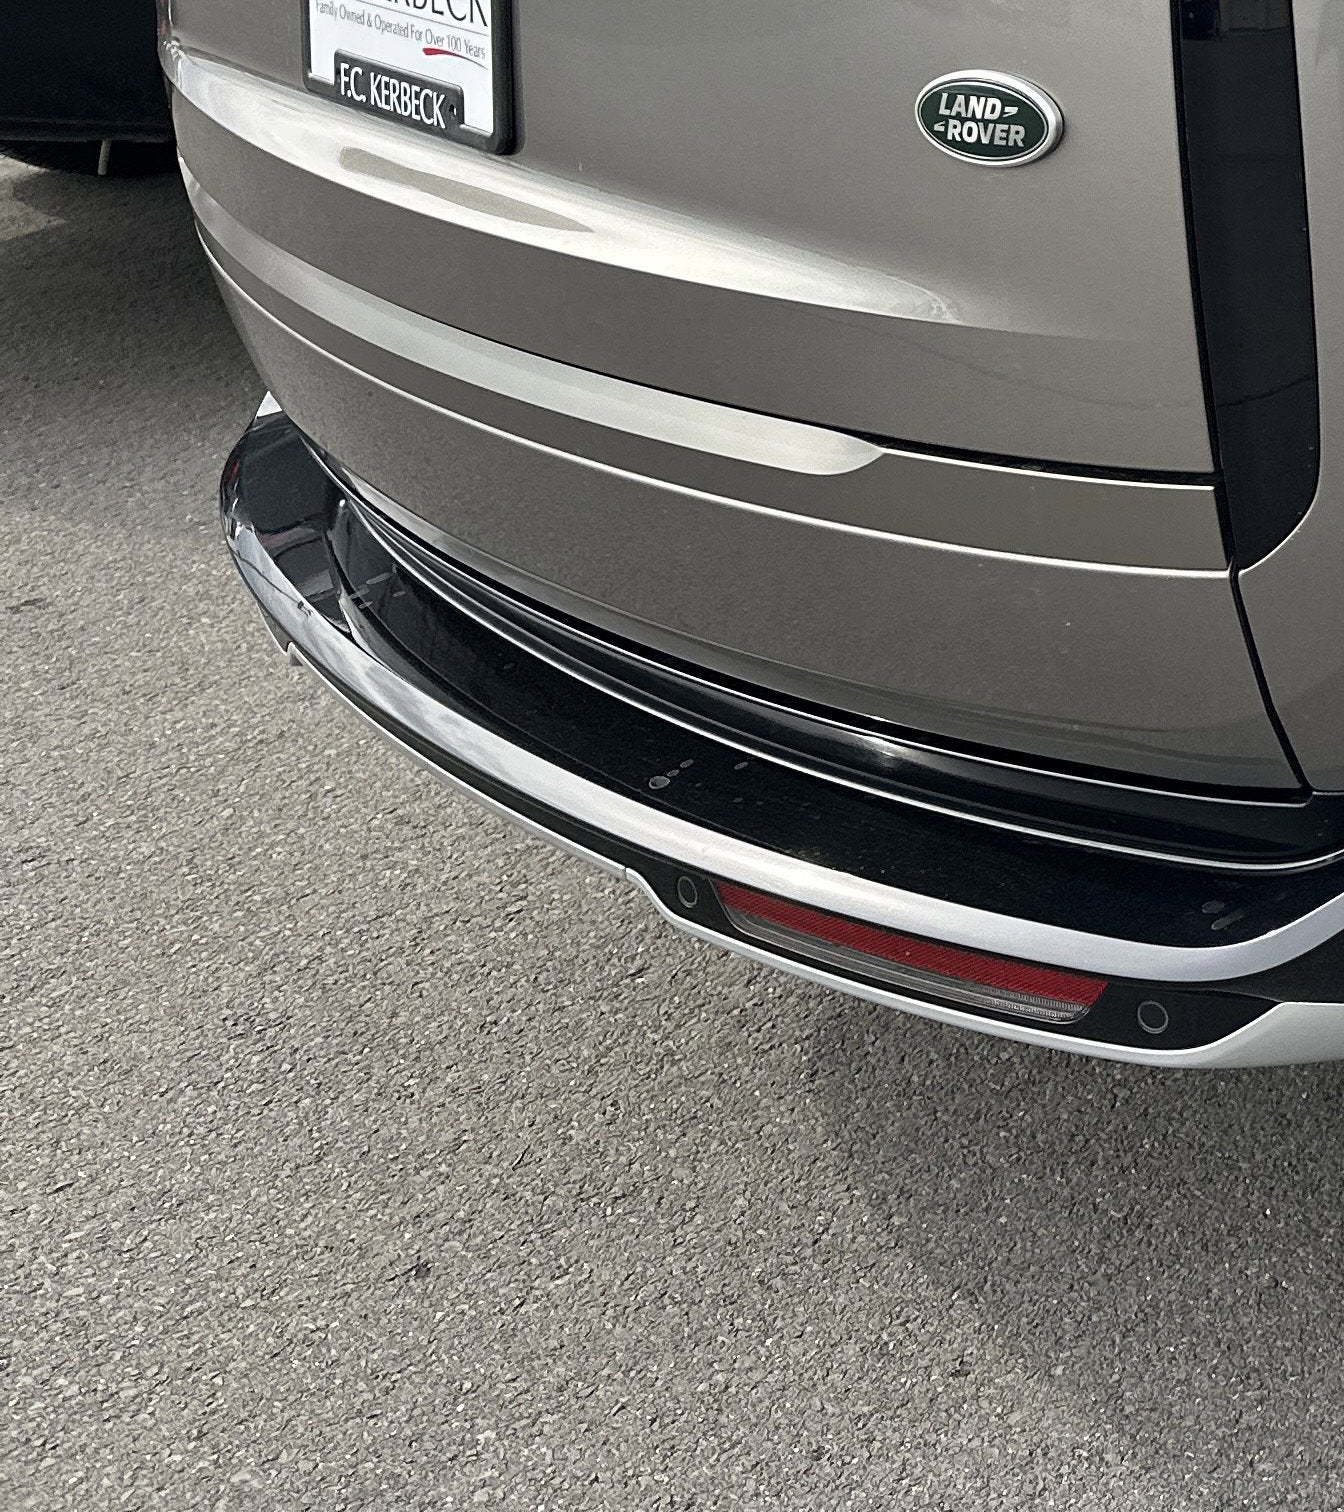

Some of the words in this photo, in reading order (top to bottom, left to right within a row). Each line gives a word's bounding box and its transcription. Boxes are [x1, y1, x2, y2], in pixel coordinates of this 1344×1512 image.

[339, 4, 365, 26] Owned
[366, 13, 373, 29] &
[374, 14, 409, 39] Operated
[410, 25, 423, 42] For
[425, 28, 445, 46] Over
[447, 34, 462, 52] 100
[463, 38, 486, 60] Years
[340, 62, 367, 103] F.C.
[369, 71, 447, 129] KERBECK
[939, 93, 1001, 119] LAND
[947, 119, 1025, 147] ROVER
